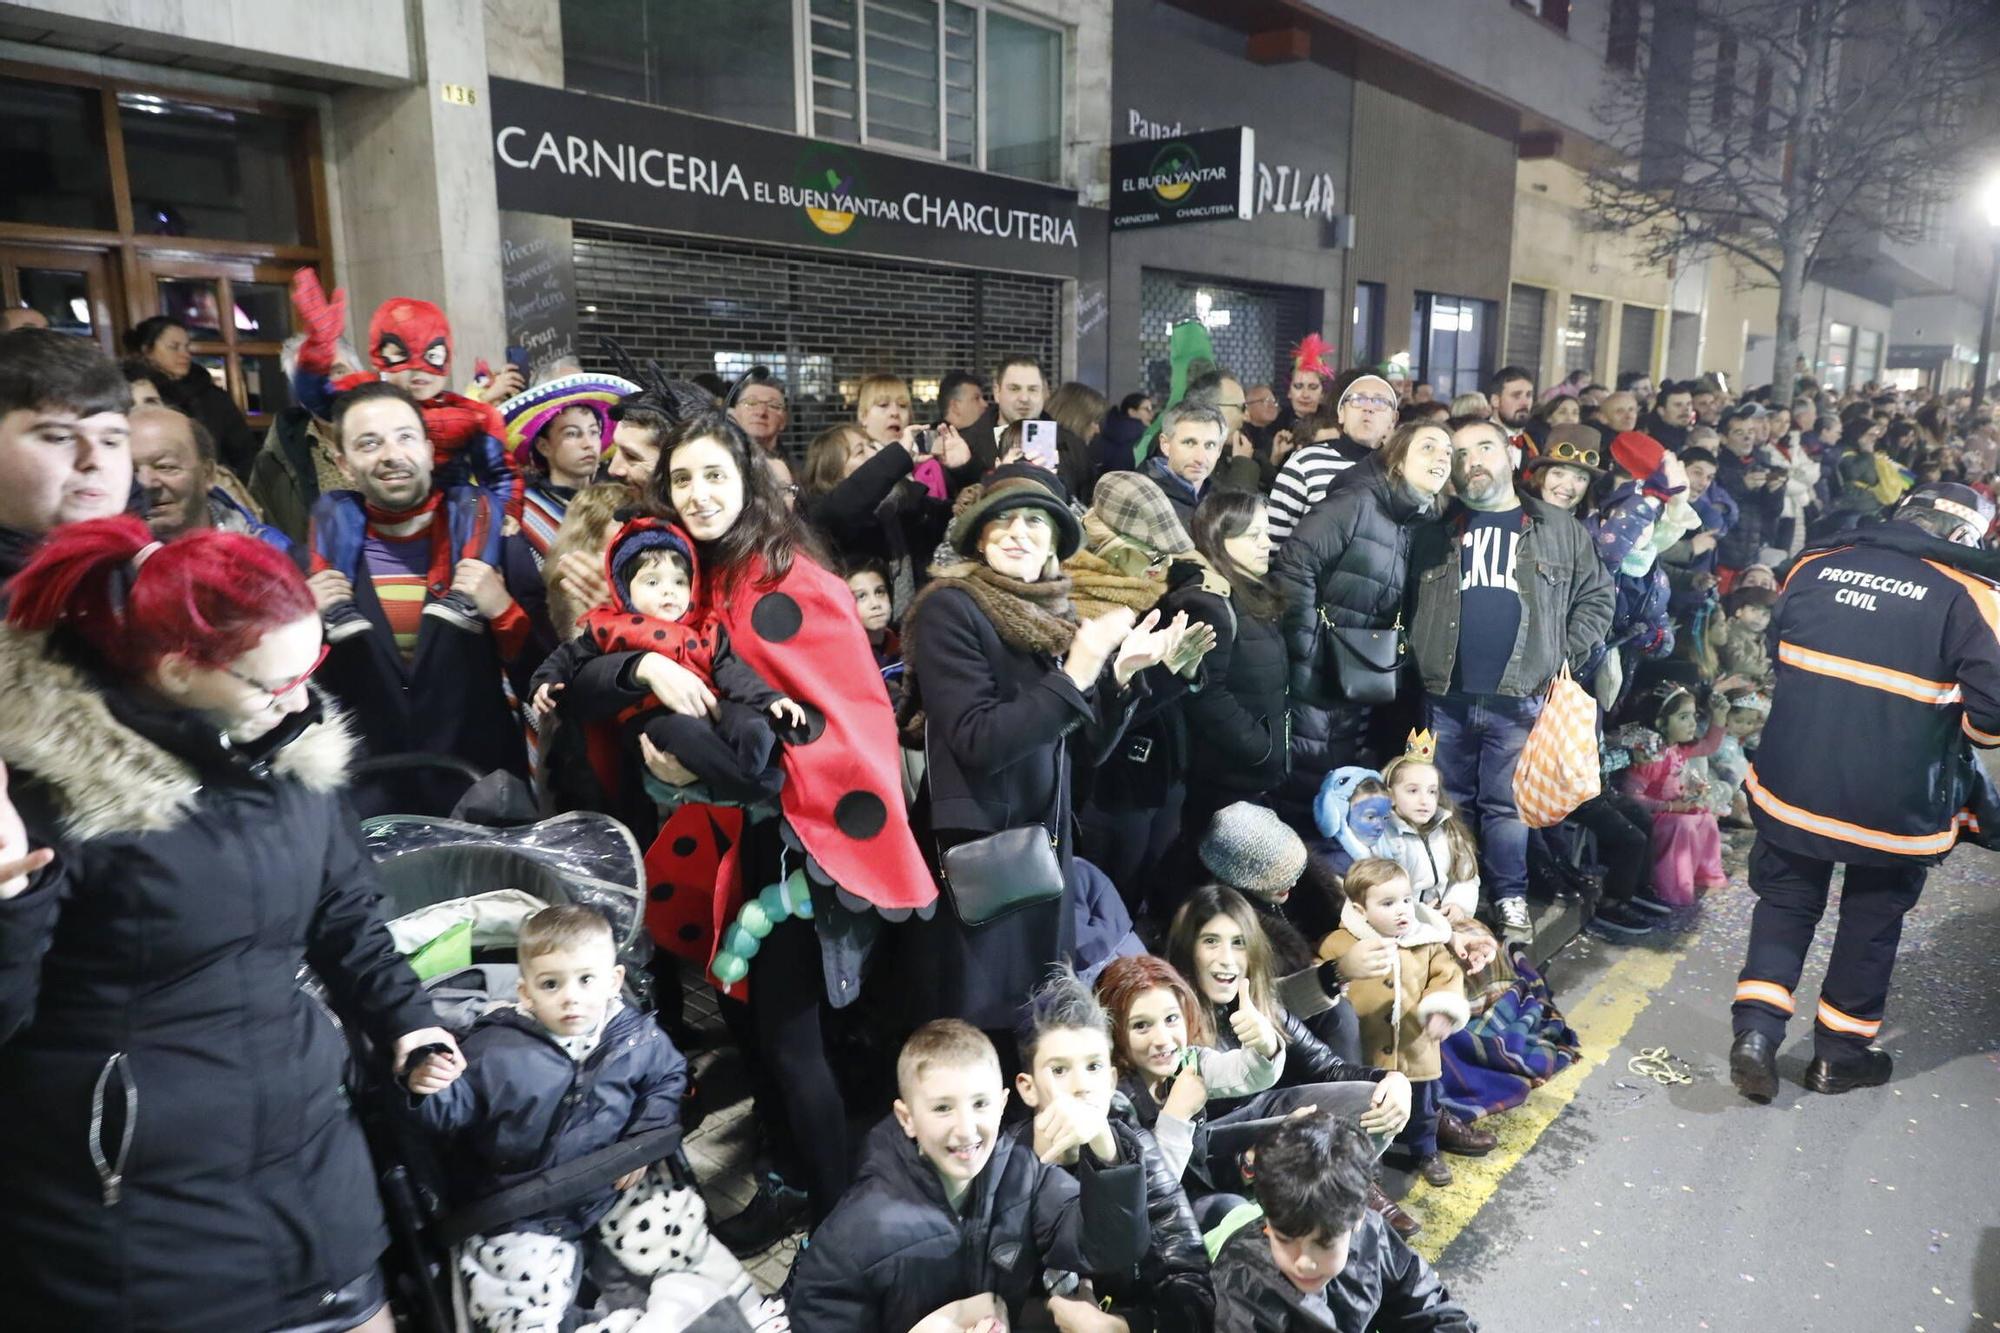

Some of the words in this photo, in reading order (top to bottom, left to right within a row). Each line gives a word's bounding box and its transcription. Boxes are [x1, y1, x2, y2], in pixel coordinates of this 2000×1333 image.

[445, 85, 476, 105] 136
[1128, 108, 1204, 140] Panad
[497, 126, 749, 200] CARNICERIA
[754, 181, 775, 204] EL
[778, 186, 829, 210] BUEN
[831, 192, 900, 221] YANTAR
[902, 193, 1078, 247] CHARCUTERIA
[1122, 178, 1136, 192] EL
[1138, 174, 1173, 190] BUEN
[1175, 166, 1227, 184] YANTAR
[1257, 162, 1335, 221] PILAR
[1114, 213, 1160, 226] CARNICERIA
[1176, 205, 1234, 218] CHARCUTERIA
[519, 326, 558, 352] Gran
[1817, 567, 1929, 600] PROTECCIÓN
[1834, 588, 1877, 611] CIVIL
